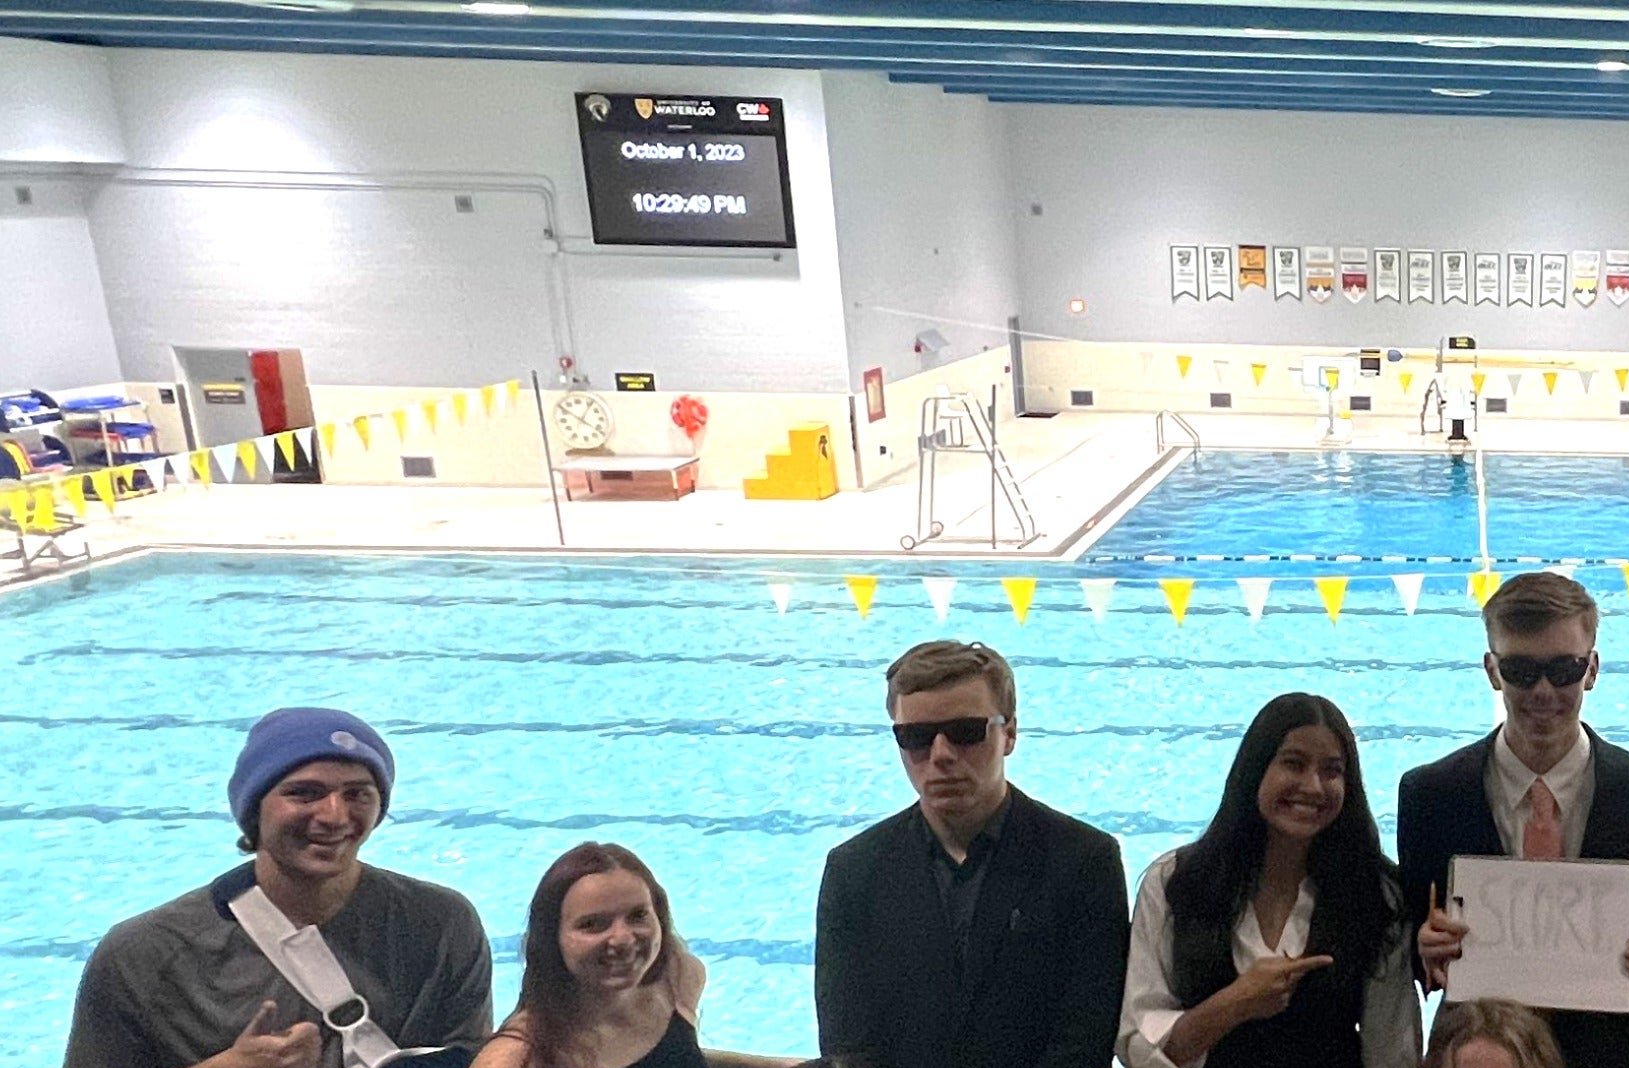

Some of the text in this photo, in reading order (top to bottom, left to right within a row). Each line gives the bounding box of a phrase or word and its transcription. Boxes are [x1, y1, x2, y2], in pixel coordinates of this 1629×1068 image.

[654, 105, 716, 116] WATERLOO
[621, 141, 745, 161] October 1, 2023
[632, 192, 747, 214] 10:29:49 PM
